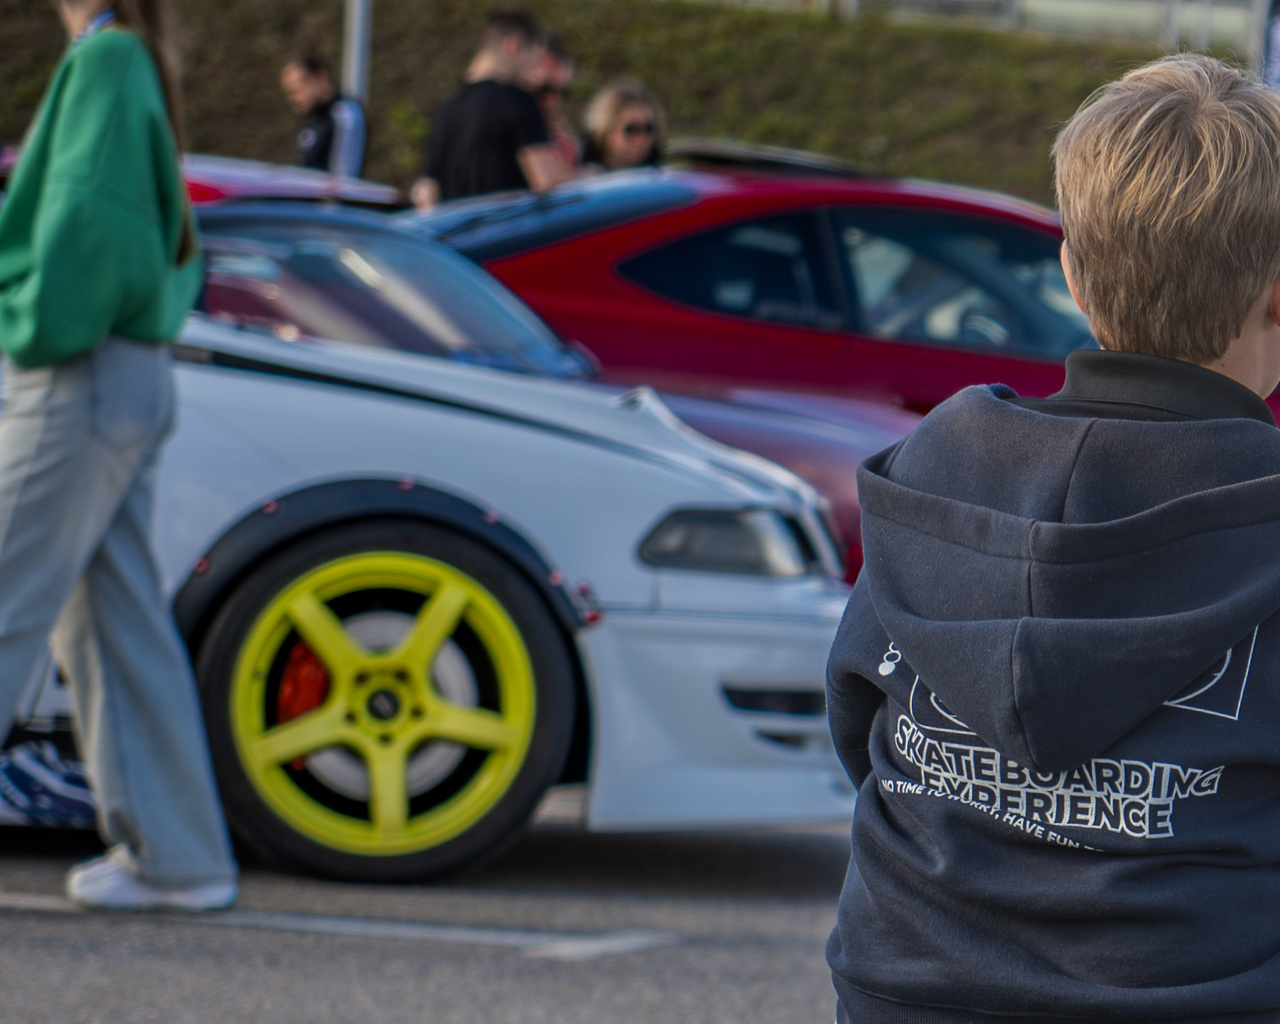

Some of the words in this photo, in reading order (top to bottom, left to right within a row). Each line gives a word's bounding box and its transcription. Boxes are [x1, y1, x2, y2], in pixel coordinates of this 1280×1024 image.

[895, 714, 1225, 801] SKATEBOARDING
[881, 779, 894, 793] NO
[896, 781, 926, 795] TIME
[1003, 812, 1046, 839] HAVE
[1047, 831, 1080, 849] FUN
[921, 766, 1175, 839] EXPERIENCE
